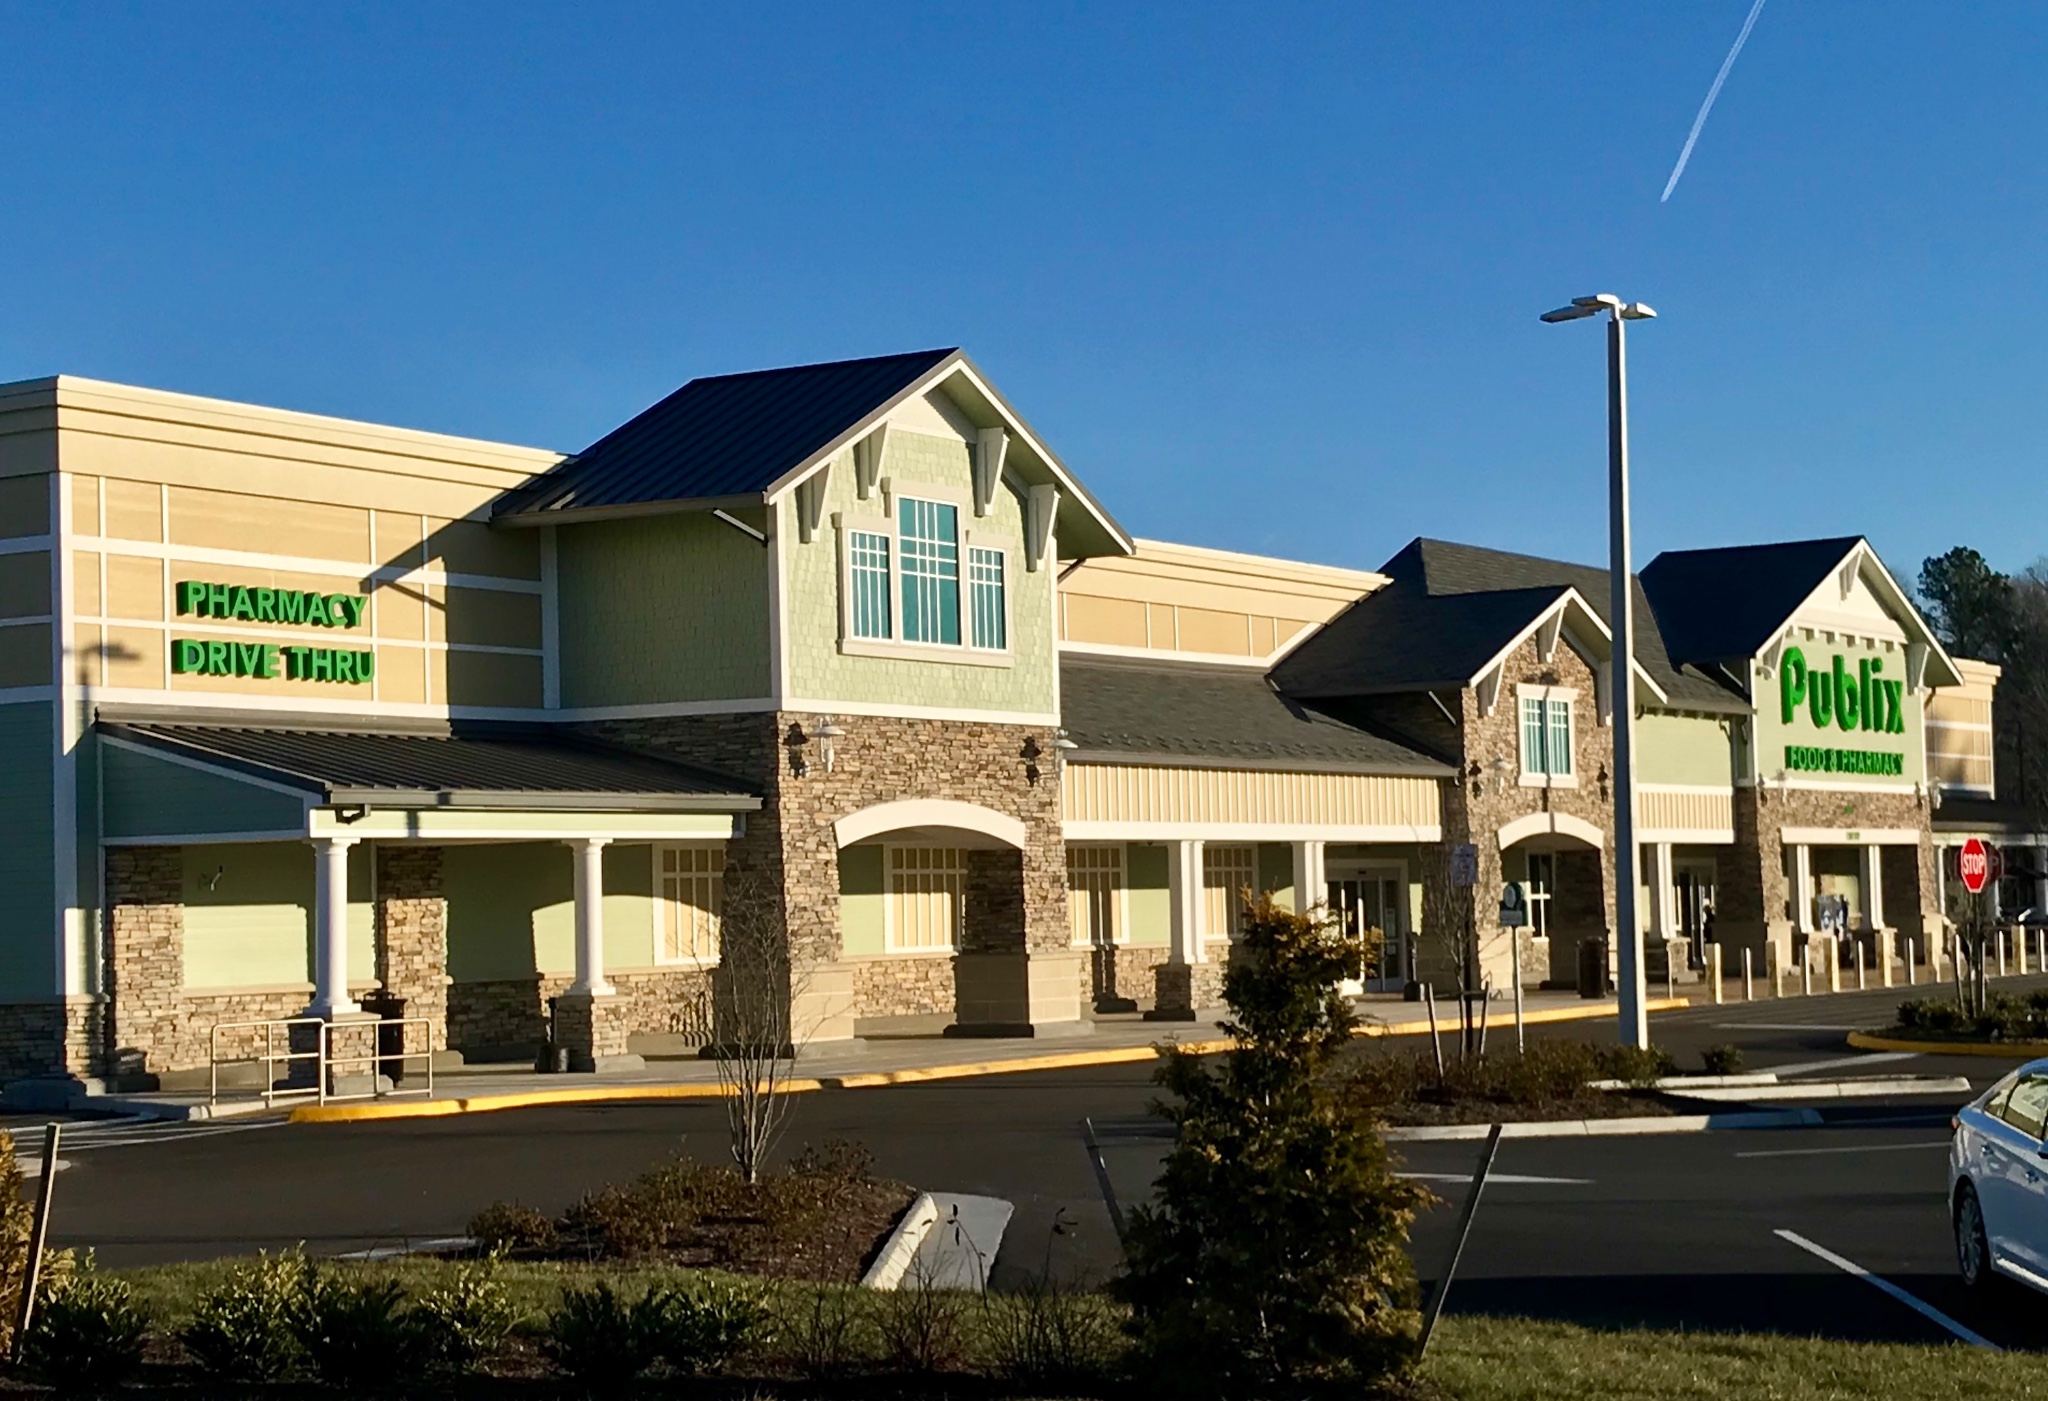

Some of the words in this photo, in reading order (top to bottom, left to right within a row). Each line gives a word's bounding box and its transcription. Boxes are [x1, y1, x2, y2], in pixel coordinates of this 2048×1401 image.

[177, 581, 367, 628] PHARMACY
[173, 639, 280, 678] DRIVE
[284, 645, 374, 684] THRU
[1780, 646, 1905, 734] Publix
[1786, 746, 1826, 771] FOOD
[1839, 750, 1903, 775] PHARMACY
[1963, 853, 1985, 875] STOP
